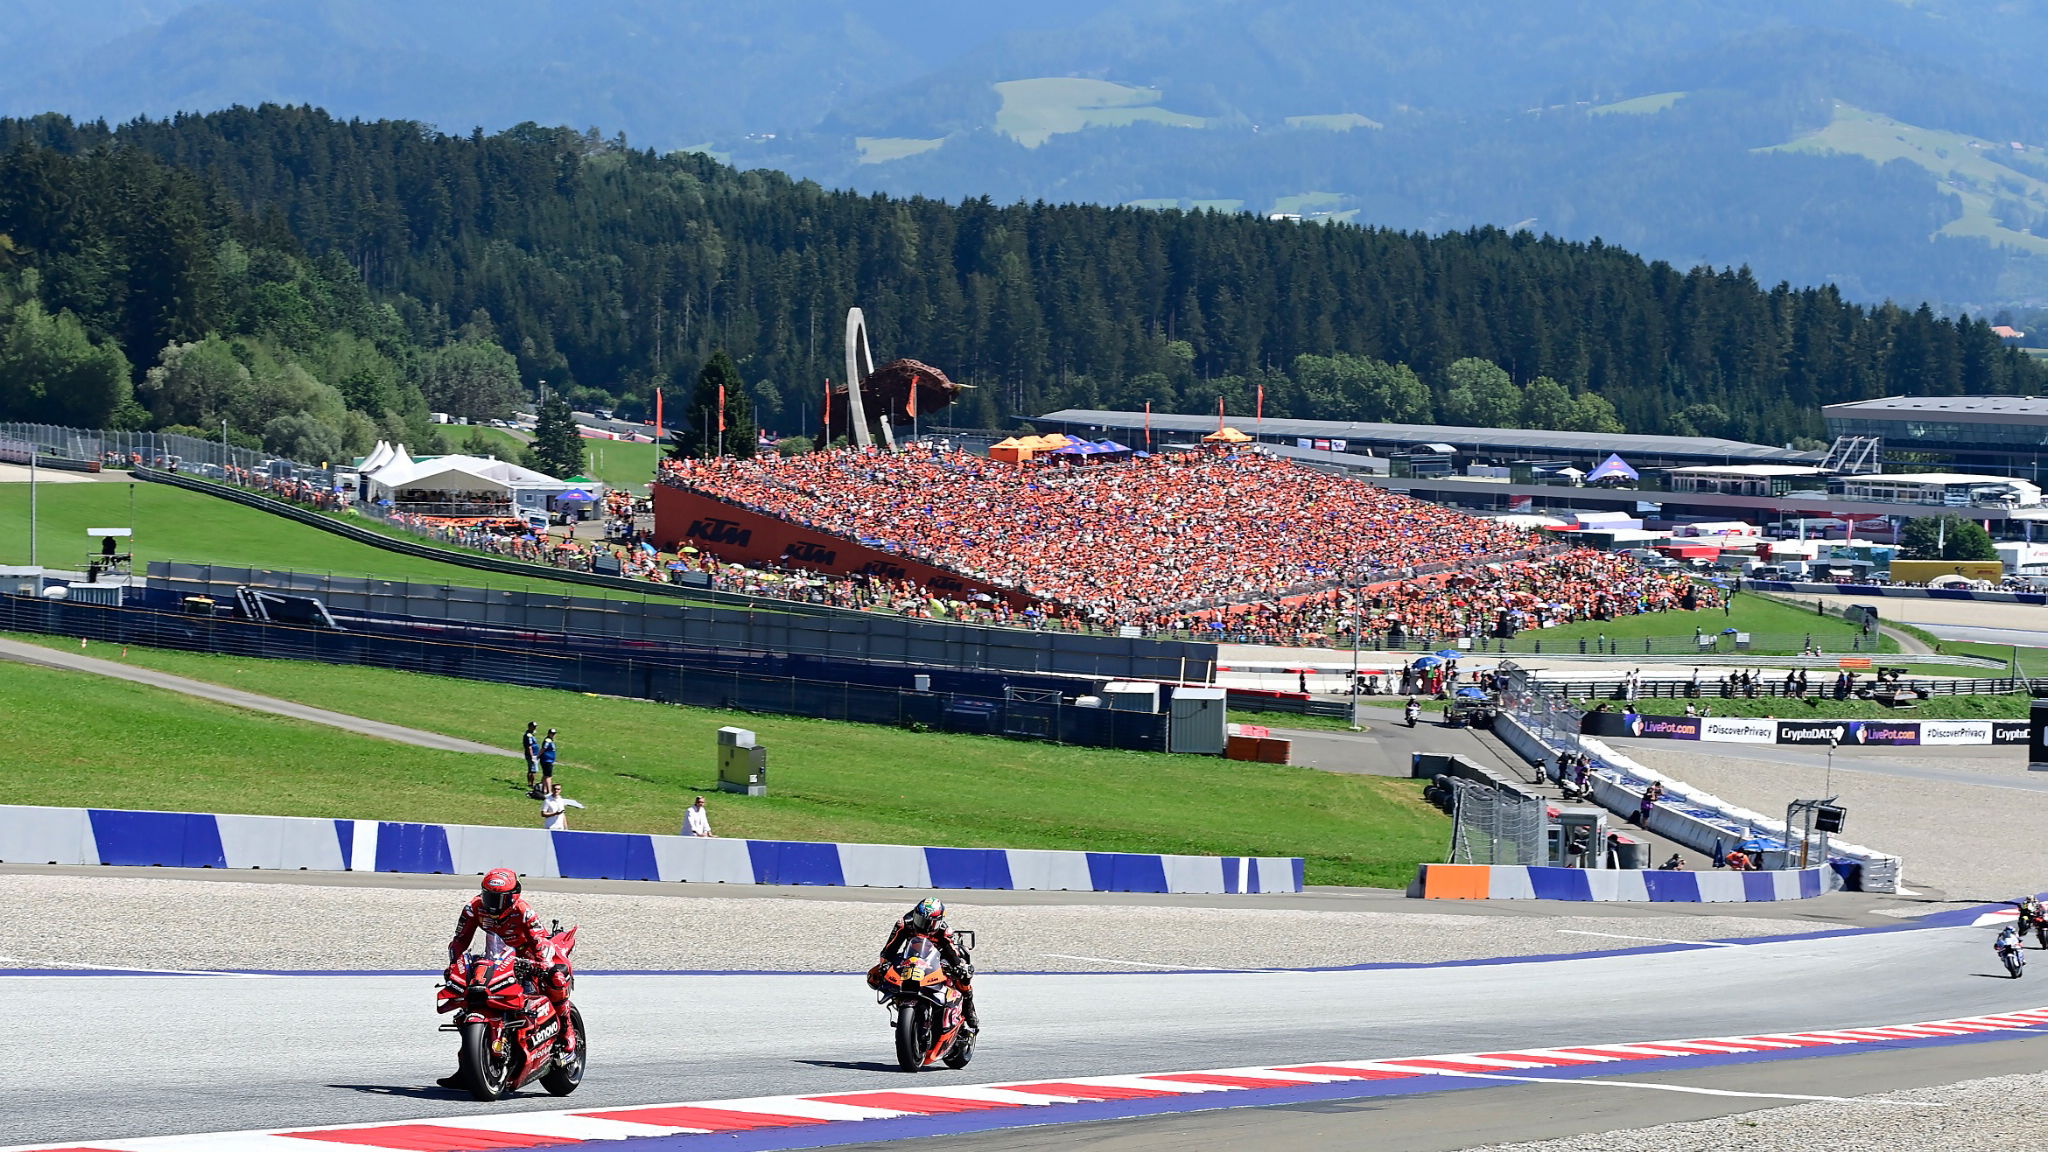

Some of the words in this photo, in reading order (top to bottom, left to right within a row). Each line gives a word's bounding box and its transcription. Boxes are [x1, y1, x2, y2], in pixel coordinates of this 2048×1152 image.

[686, 517, 752, 547] KTM
[784, 541, 836, 566] KTM
[1644, 720, 1696, 735] LivePot.com
[1707, 724, 1772, 739] #DiscoverPrivacy
[1868, 729, 1916, 740] LivePot.com
[1927, 728, 1987, 740] #DiscoverPrivacy
[531, 1021, 558, 1047] Lenovo
